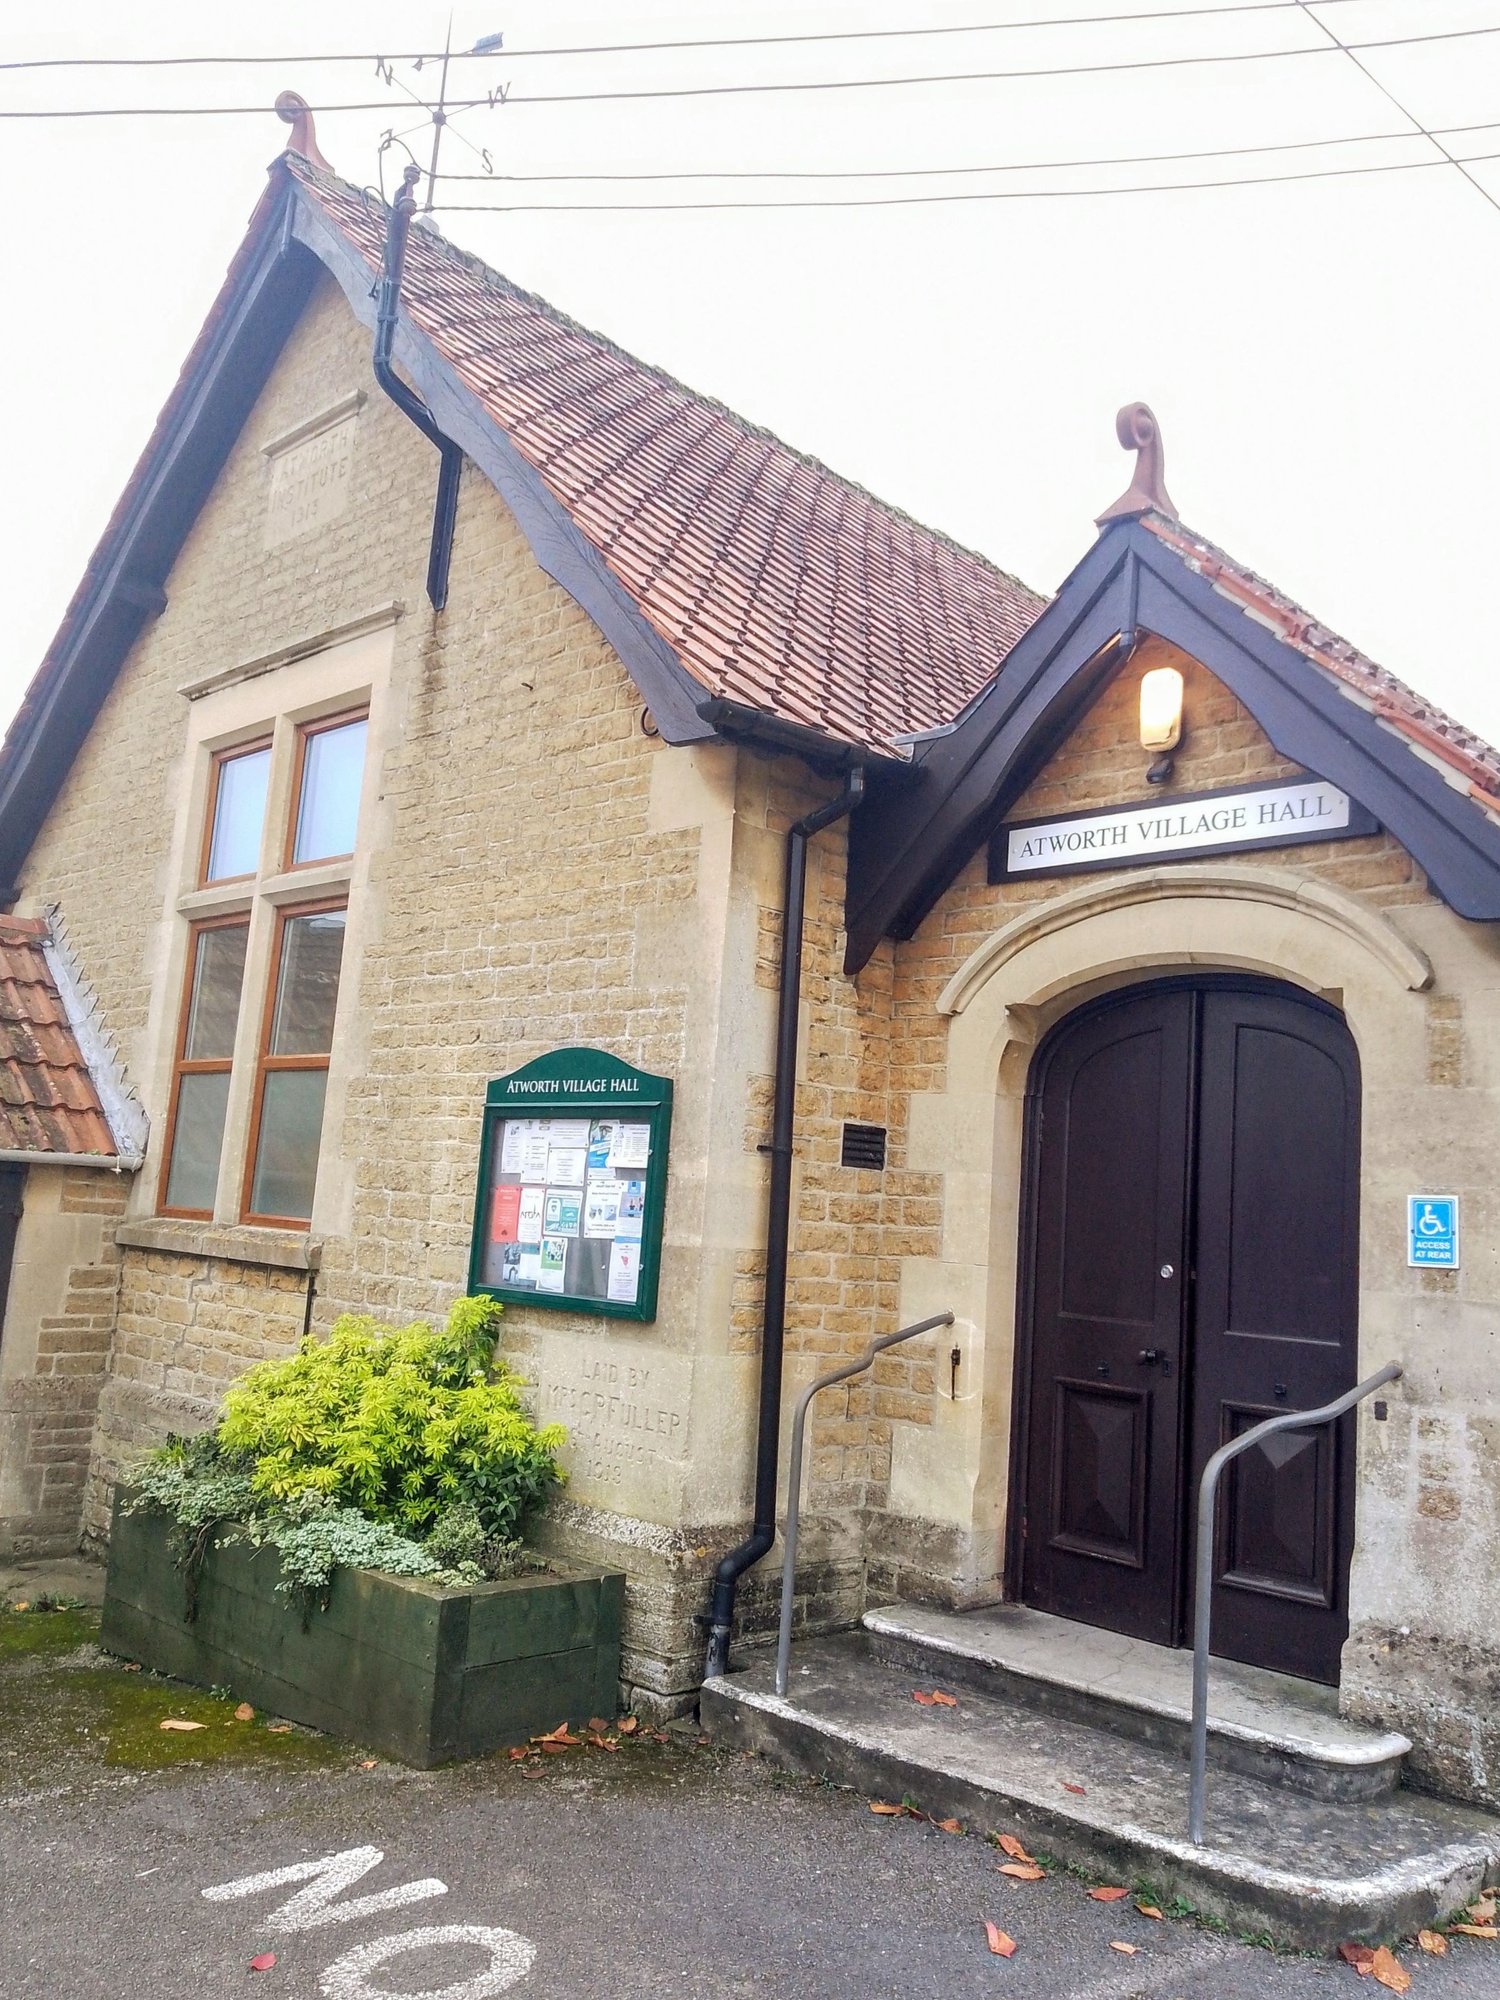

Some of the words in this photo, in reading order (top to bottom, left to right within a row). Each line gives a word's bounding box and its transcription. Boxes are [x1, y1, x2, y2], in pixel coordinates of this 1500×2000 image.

[1019, 824, 1128, 858] ATWORTH
[1137, 806, 1247, 841] VILLAGE
[1257, 795, 1333, 825] HALL
[506, 1079, 560, 1094] ATWORTH
[562, 1078, 607, 1093] VILLAGE
[610, 1078, 640, 1093] HALL
[1415, 1241, 1451, 1250] ACCESS
[1415, 1250, 1426, 1259] AT
[1427, 1250, 1452, 1260] REAR
[581, 1359, 618, 1385] LAID
[628, 1367, 650, 1390] BY
